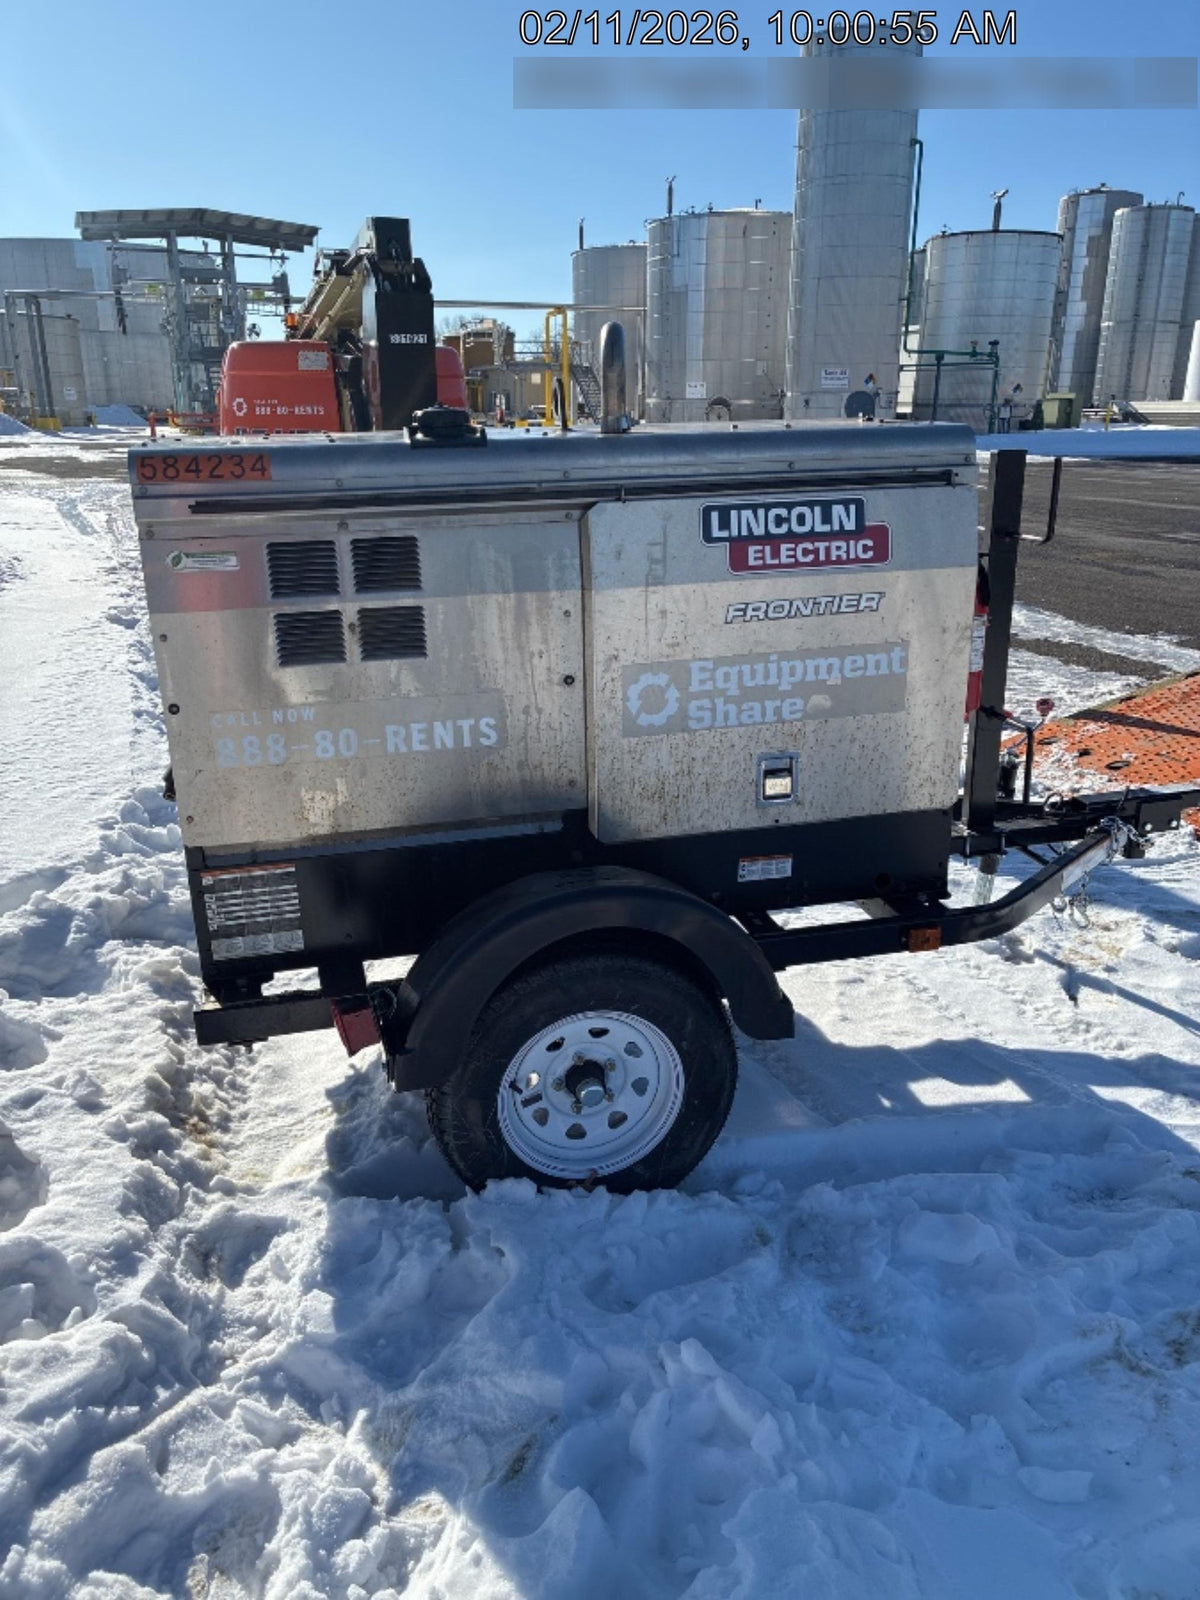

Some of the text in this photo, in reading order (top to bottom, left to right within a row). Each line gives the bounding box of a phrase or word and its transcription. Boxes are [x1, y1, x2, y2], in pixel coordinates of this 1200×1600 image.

[139, 453, 268, 481] 584234
[710, 503, 857, 538] LINCOLN
[747, 538, 875, 566] ELECTRIC
[724, 592, 885, 624] FRONTIER
[689, 646, 907, 697] Equipment
[211, 705, 316, 729] CALL NOW
[687, 697, 806, 731] Share
[214, 716, 499, 769] 888-80-RENTS
